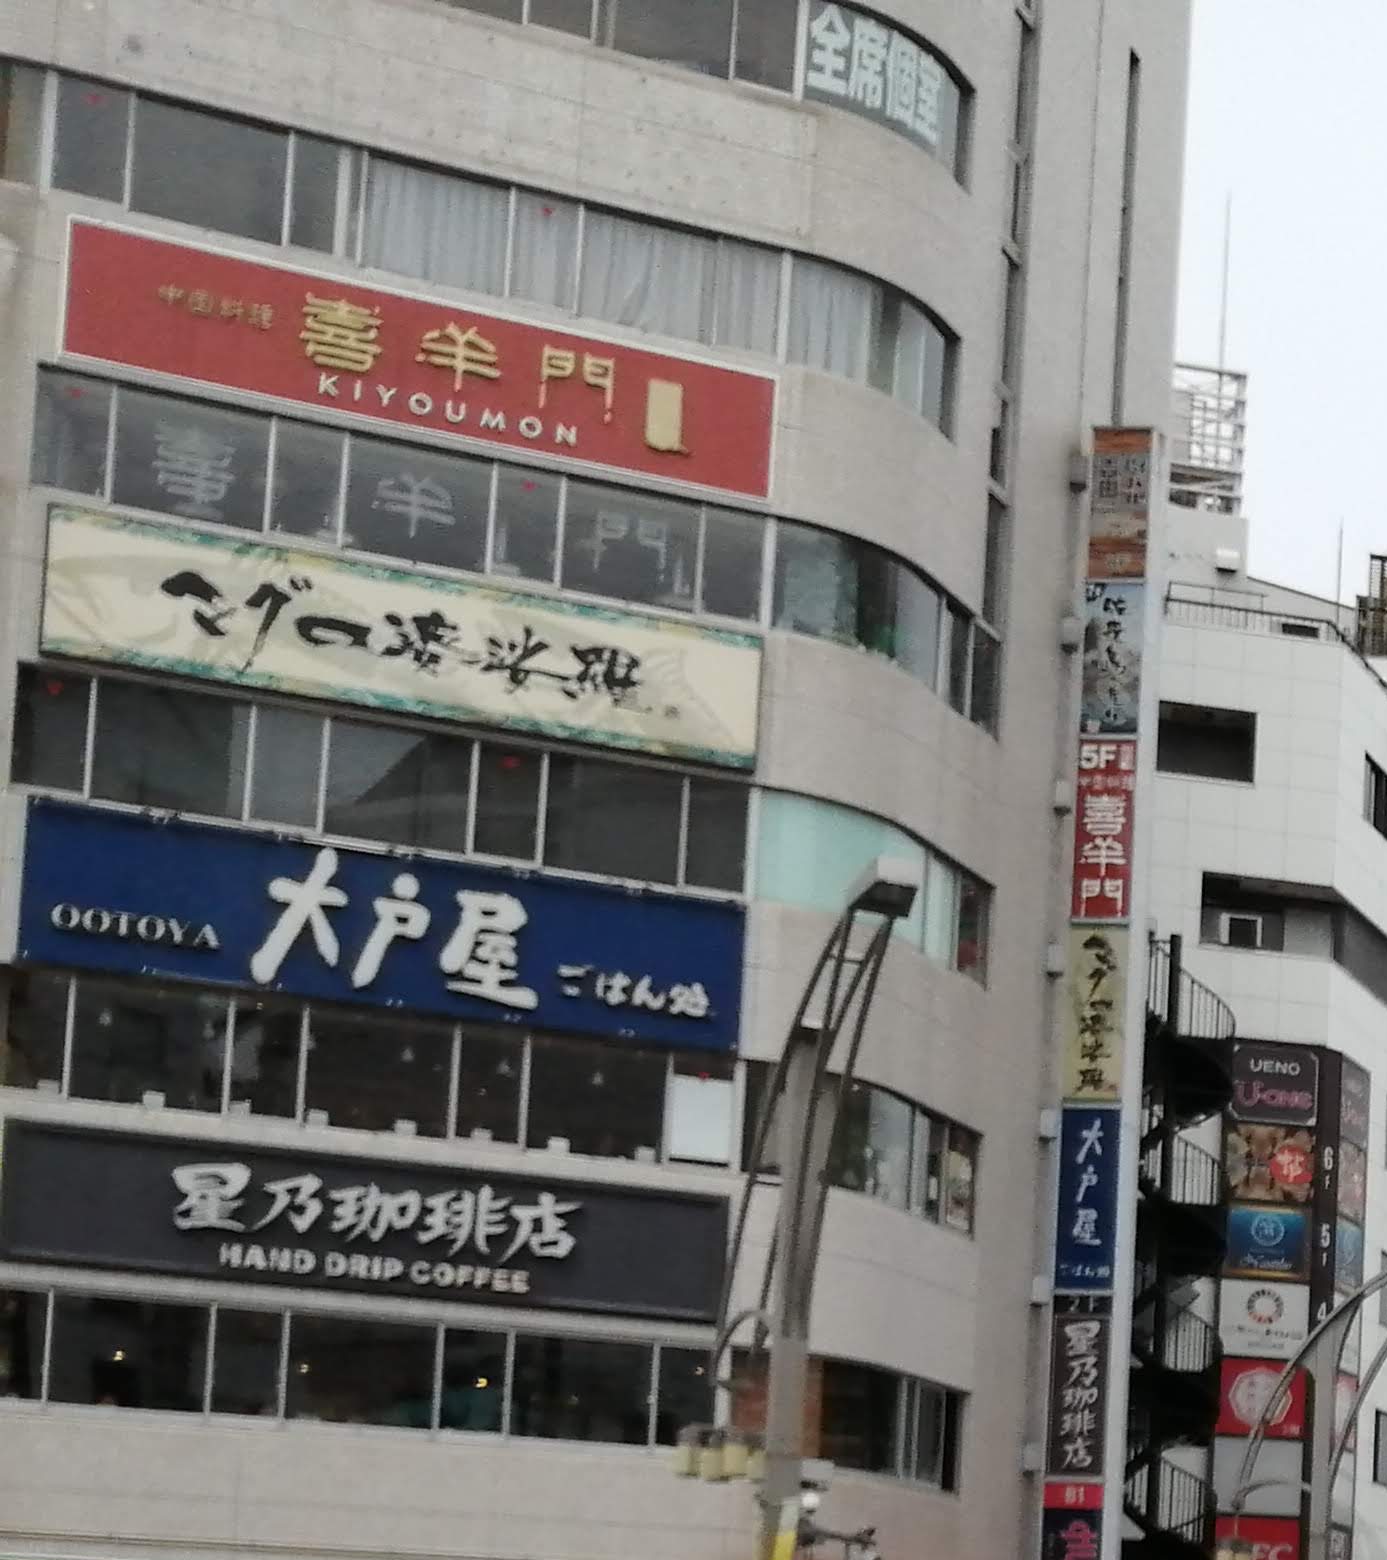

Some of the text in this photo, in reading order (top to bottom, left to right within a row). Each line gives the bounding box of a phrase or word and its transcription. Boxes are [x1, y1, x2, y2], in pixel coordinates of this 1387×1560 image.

[805, 2, 942, 146] 全席個室
[299, 290, 618, 425] 喜羊門
[317, 372, 580, 447] KIYOUMON
[1079, 743, 1118, 770] 5F
[1079, 794, 1128, 918] 喜羊門
[50, 902, 222, 951] OOTOYA
[250, 846, 540, 1013] 大戸屋
[1249, 1057, 1301, 1077] UENO
[171, 1162, 586, 1262] 星乃珈琲店
[1071, 1117, 1105, 1247] 大戸屋
[219, 1242, 531, 1296] HAND DRIP COFFEE
[1059, 1319, 1102, 1470] 星乃珈琲店
